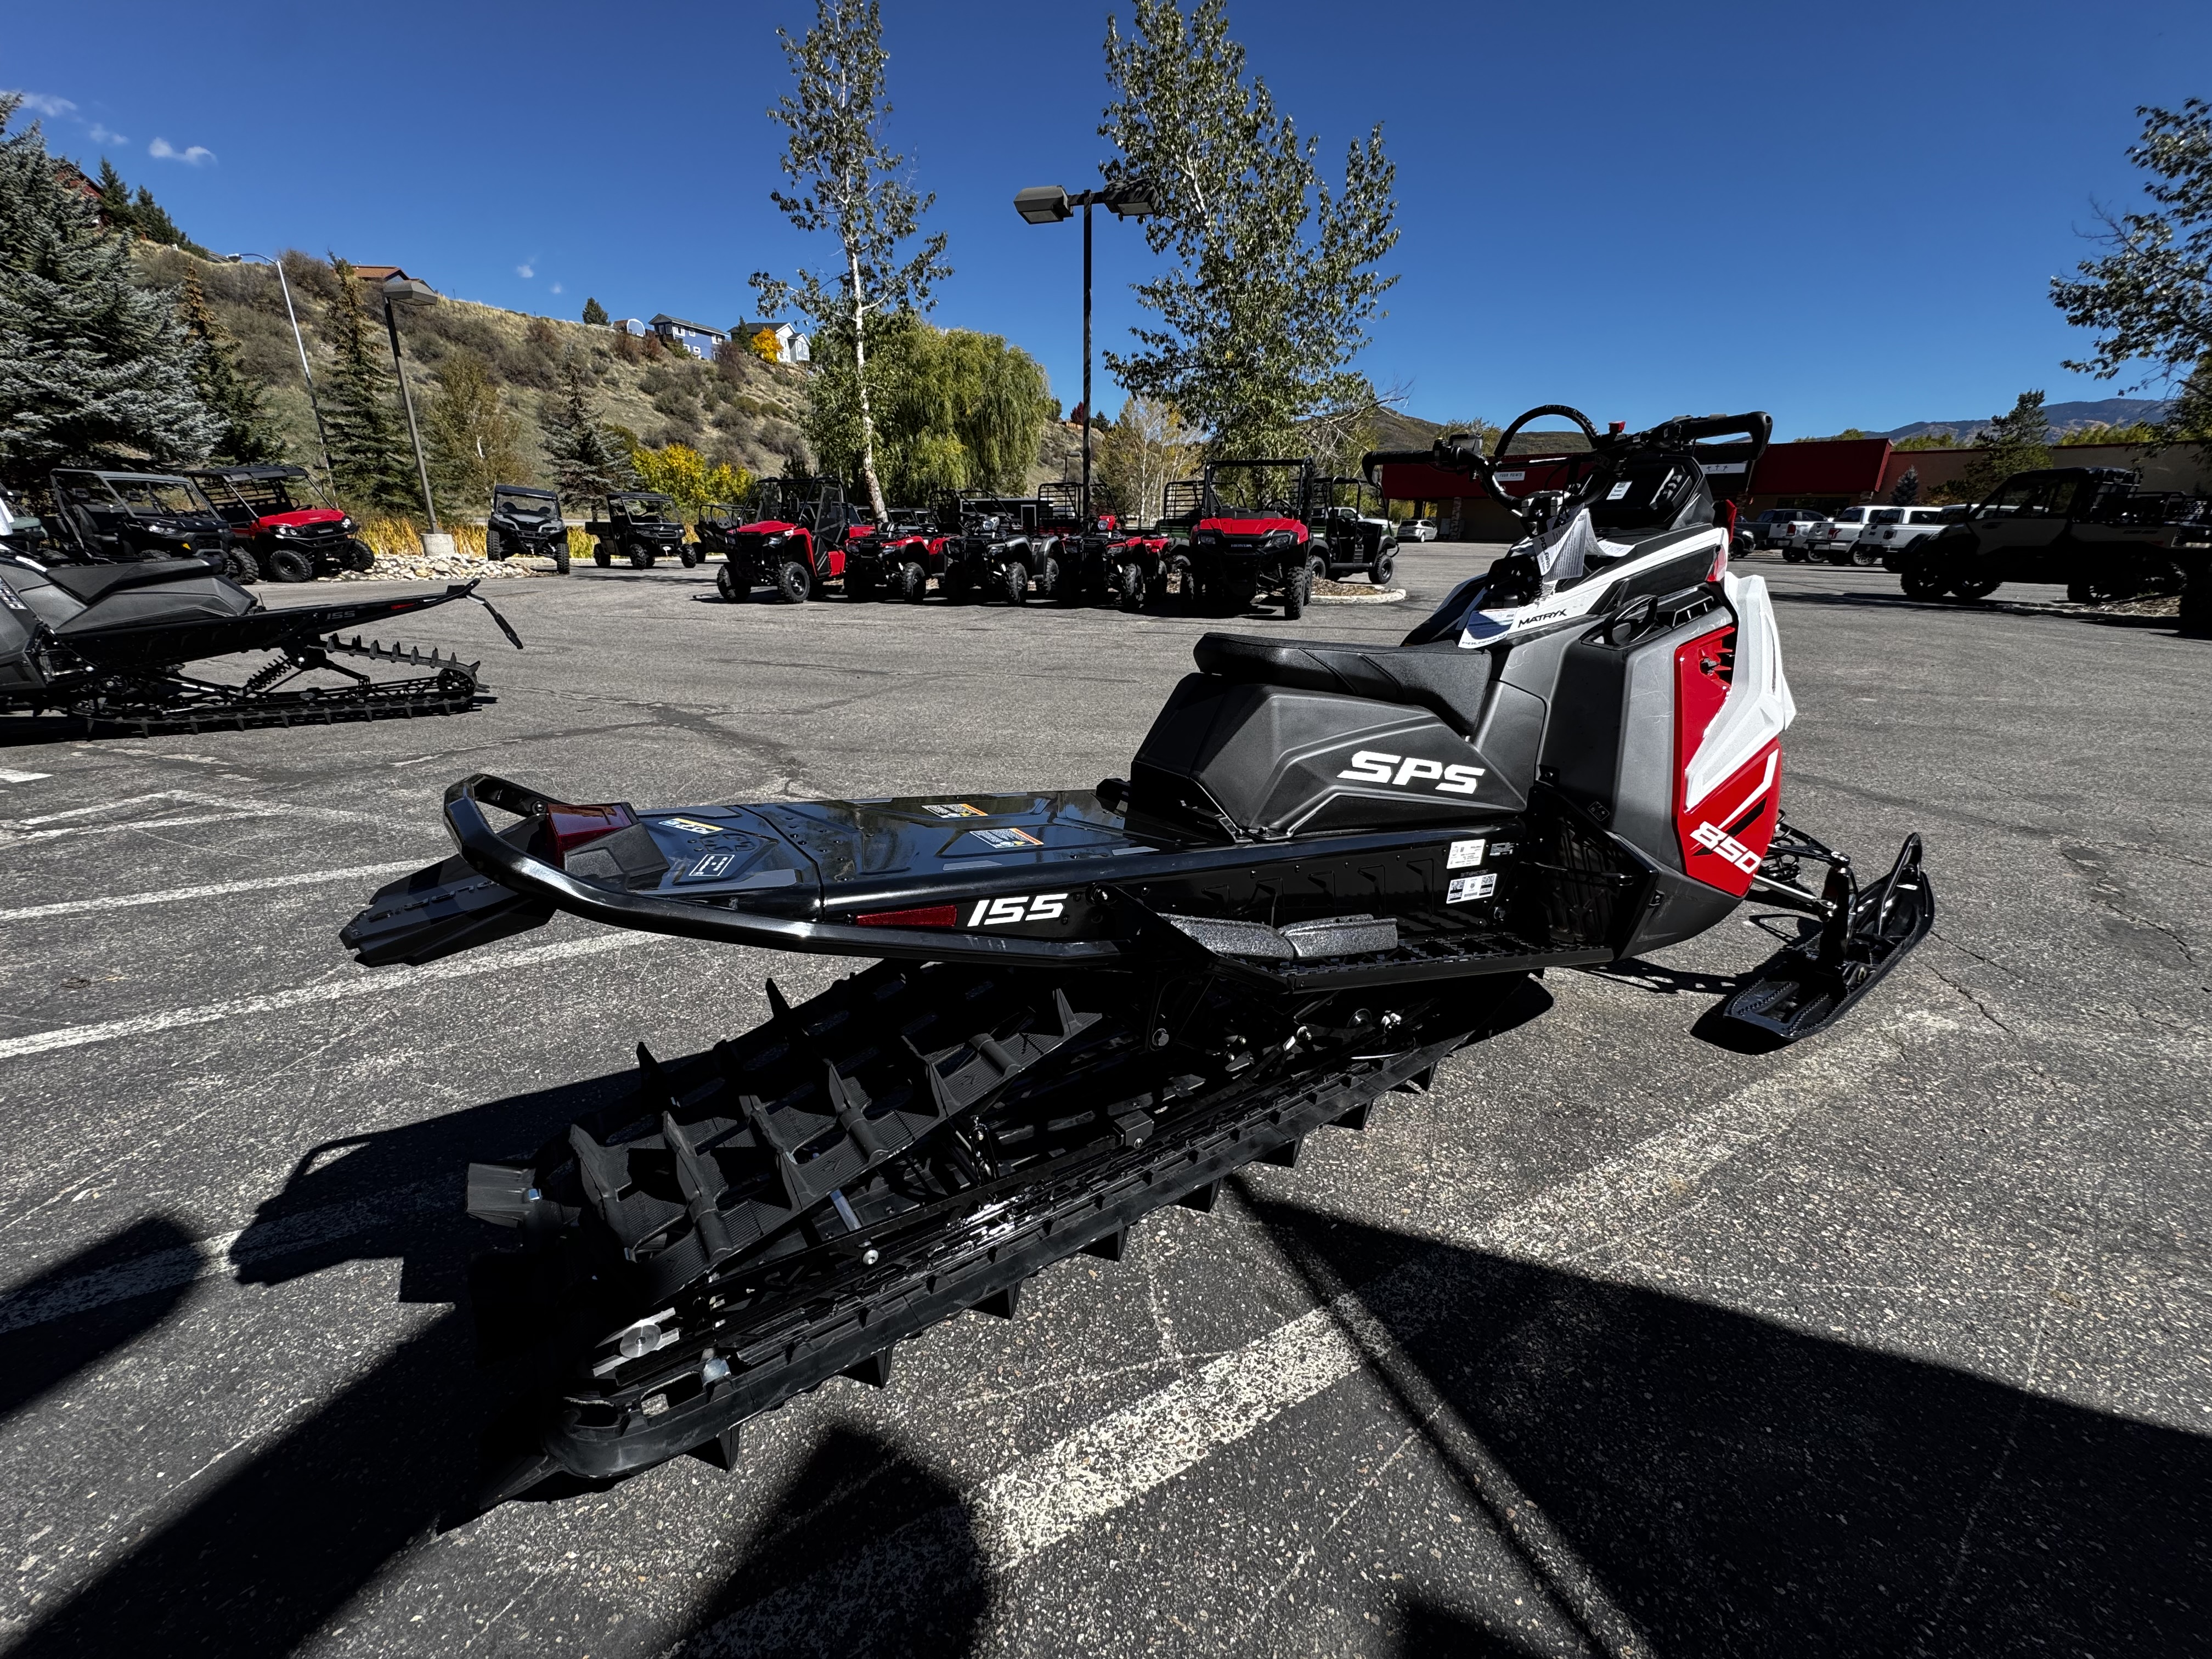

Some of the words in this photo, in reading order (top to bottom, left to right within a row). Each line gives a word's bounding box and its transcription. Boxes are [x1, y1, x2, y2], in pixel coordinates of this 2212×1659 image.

[326, 610, 356, 620] 155
[1517, 608, 1567, 628] MATRYX
[1336, 751, 1486, 794] SPS
[1689, 821, 1762, 874] 850
[967, 894, 1069, 927] 155
